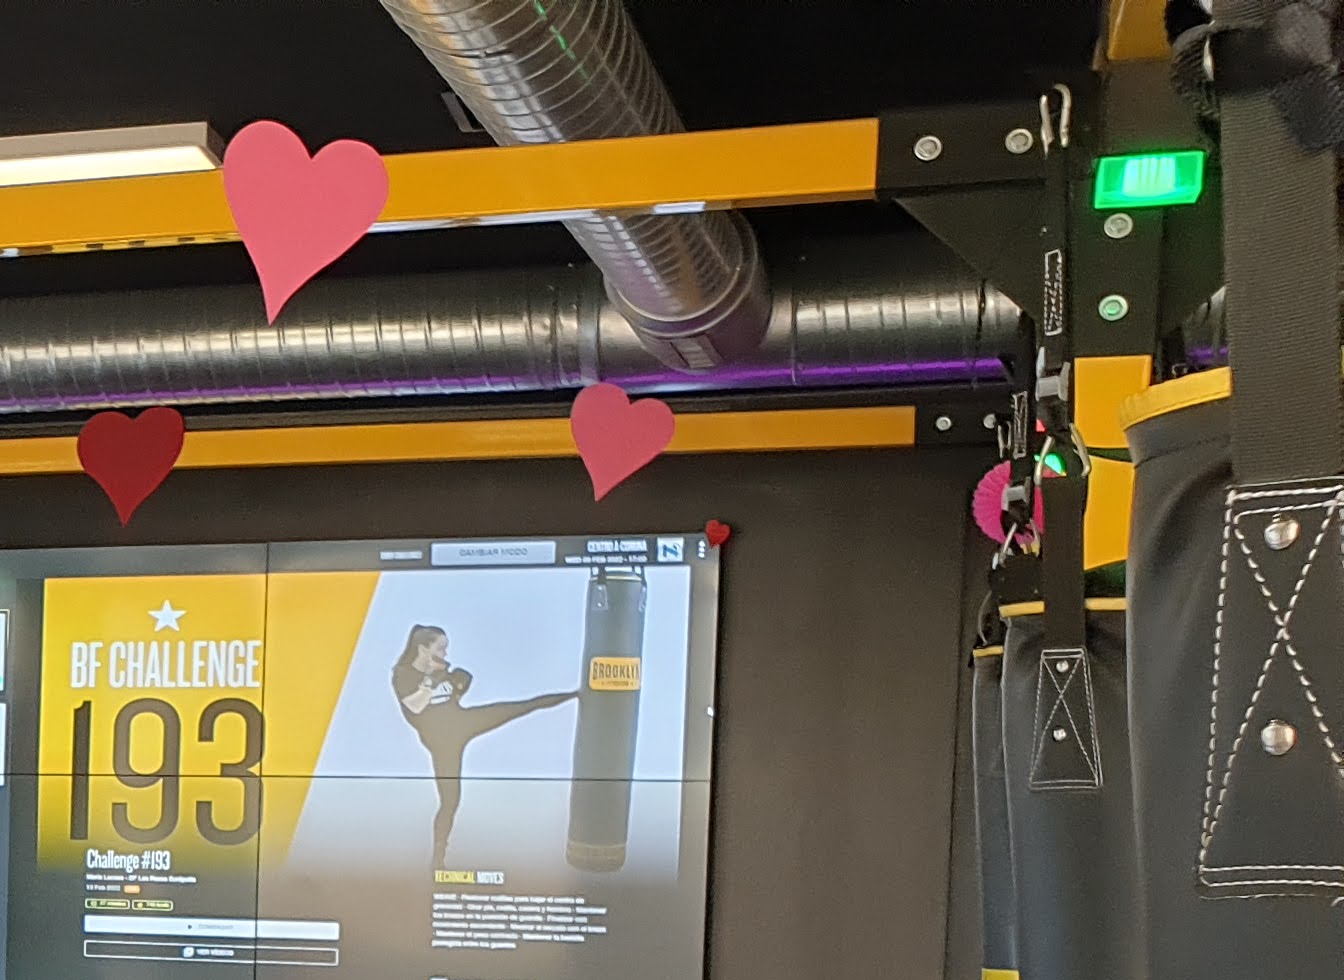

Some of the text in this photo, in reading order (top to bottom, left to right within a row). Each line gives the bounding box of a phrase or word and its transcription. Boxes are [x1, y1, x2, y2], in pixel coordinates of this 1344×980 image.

[70, 639, 262, 689] BF CHALLENGE
[70, 697, 266, 846] 193
[86, 848, 171, 874] Challenge #193
